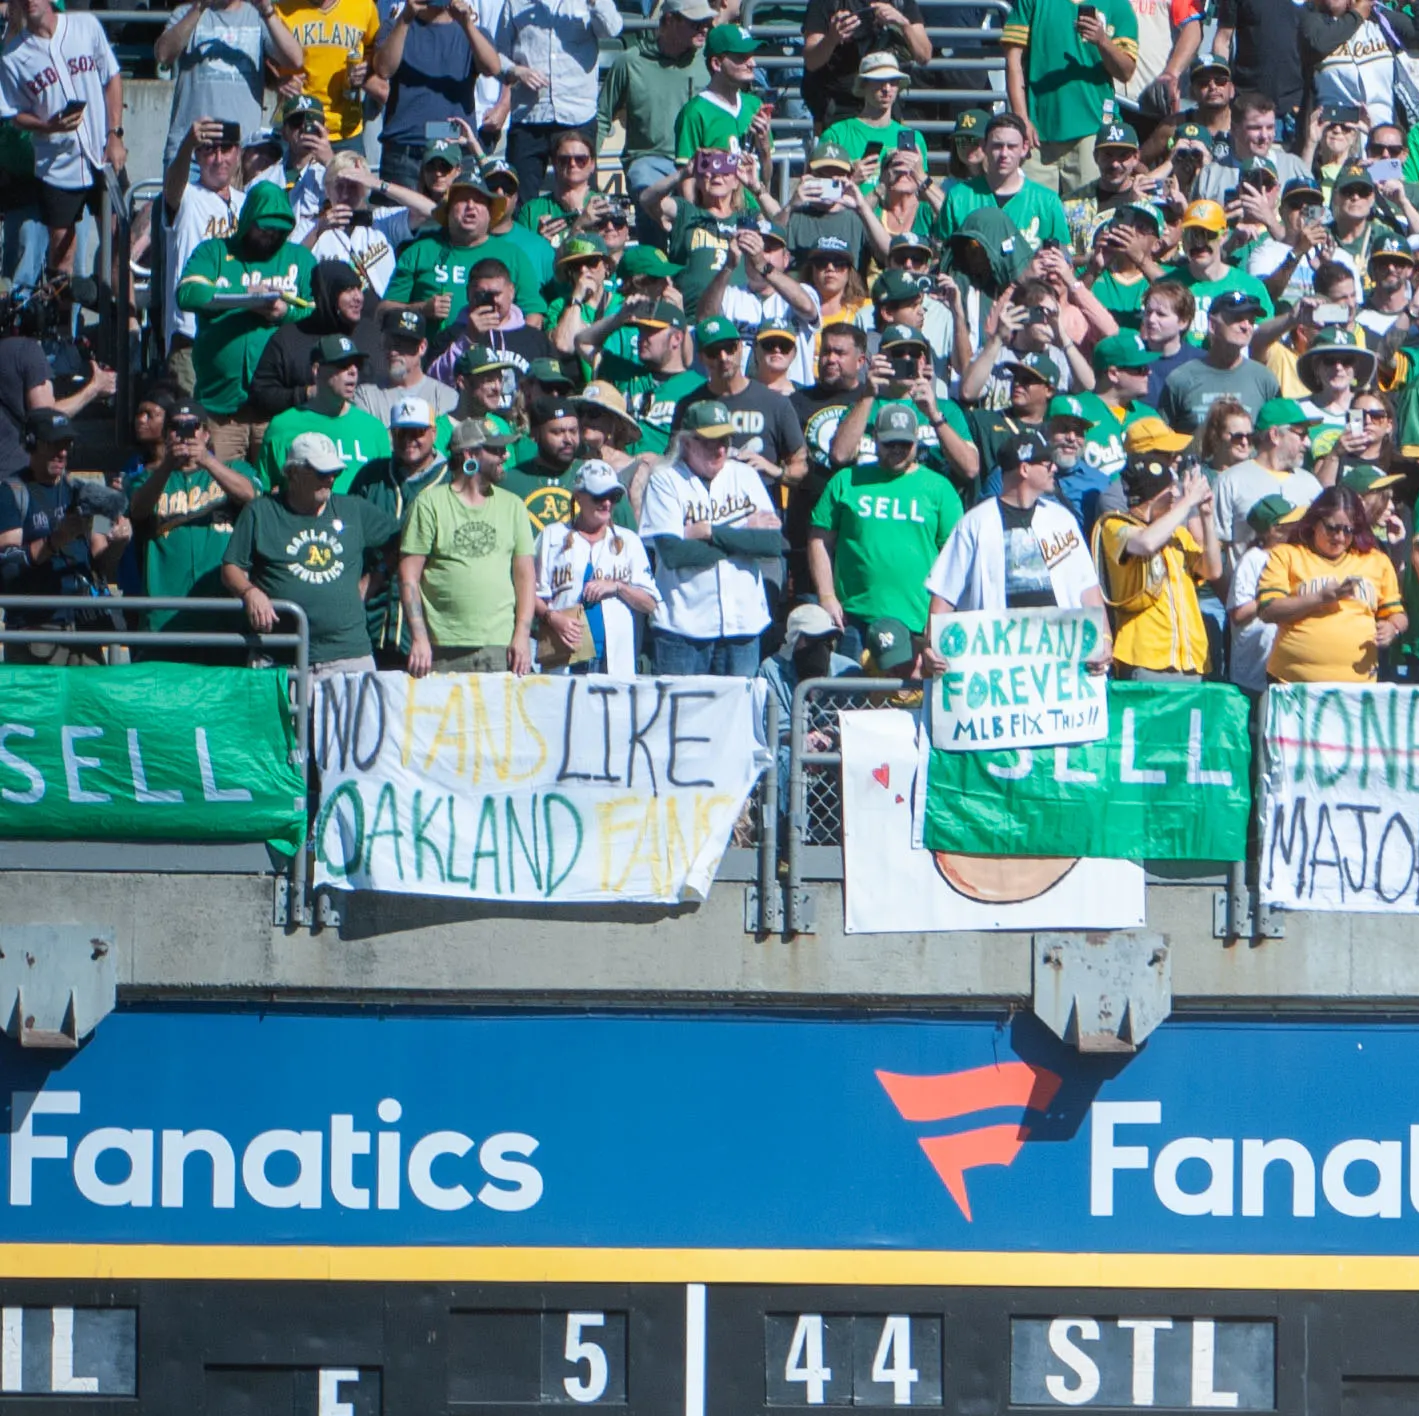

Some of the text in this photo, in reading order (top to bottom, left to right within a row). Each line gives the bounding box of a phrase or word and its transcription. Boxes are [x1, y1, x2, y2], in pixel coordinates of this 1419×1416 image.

[292, 22, 363, 46] AKLAN
[27, 54, 97, 96] RED SOX
[338, 440, 368, 462] LL
[857, 495, 924, 522] SELL
[285, 527, 343, 556] OAKLAND
[1041, 528, 1081, 560] letics
[287, 558, 345, 587] ATHLETICS
[938, 615, 1100, 660] OAKLAND
[940, 660, 1099, 713] FOREVER
[316, 670, 718, 796] NO FANS LIKE
[952, 713, 1005, 742] MLB
[1010, 711, 1044, 737] FIX
[0, 724, 252, 804] SELL
[316, 778, 585, 897] OAKLAND
[10, 1091, 544, 1212] Fanatics
[563, 1313, 608, 1403] 5
[1045, 1318, 1239, 1407] STL
